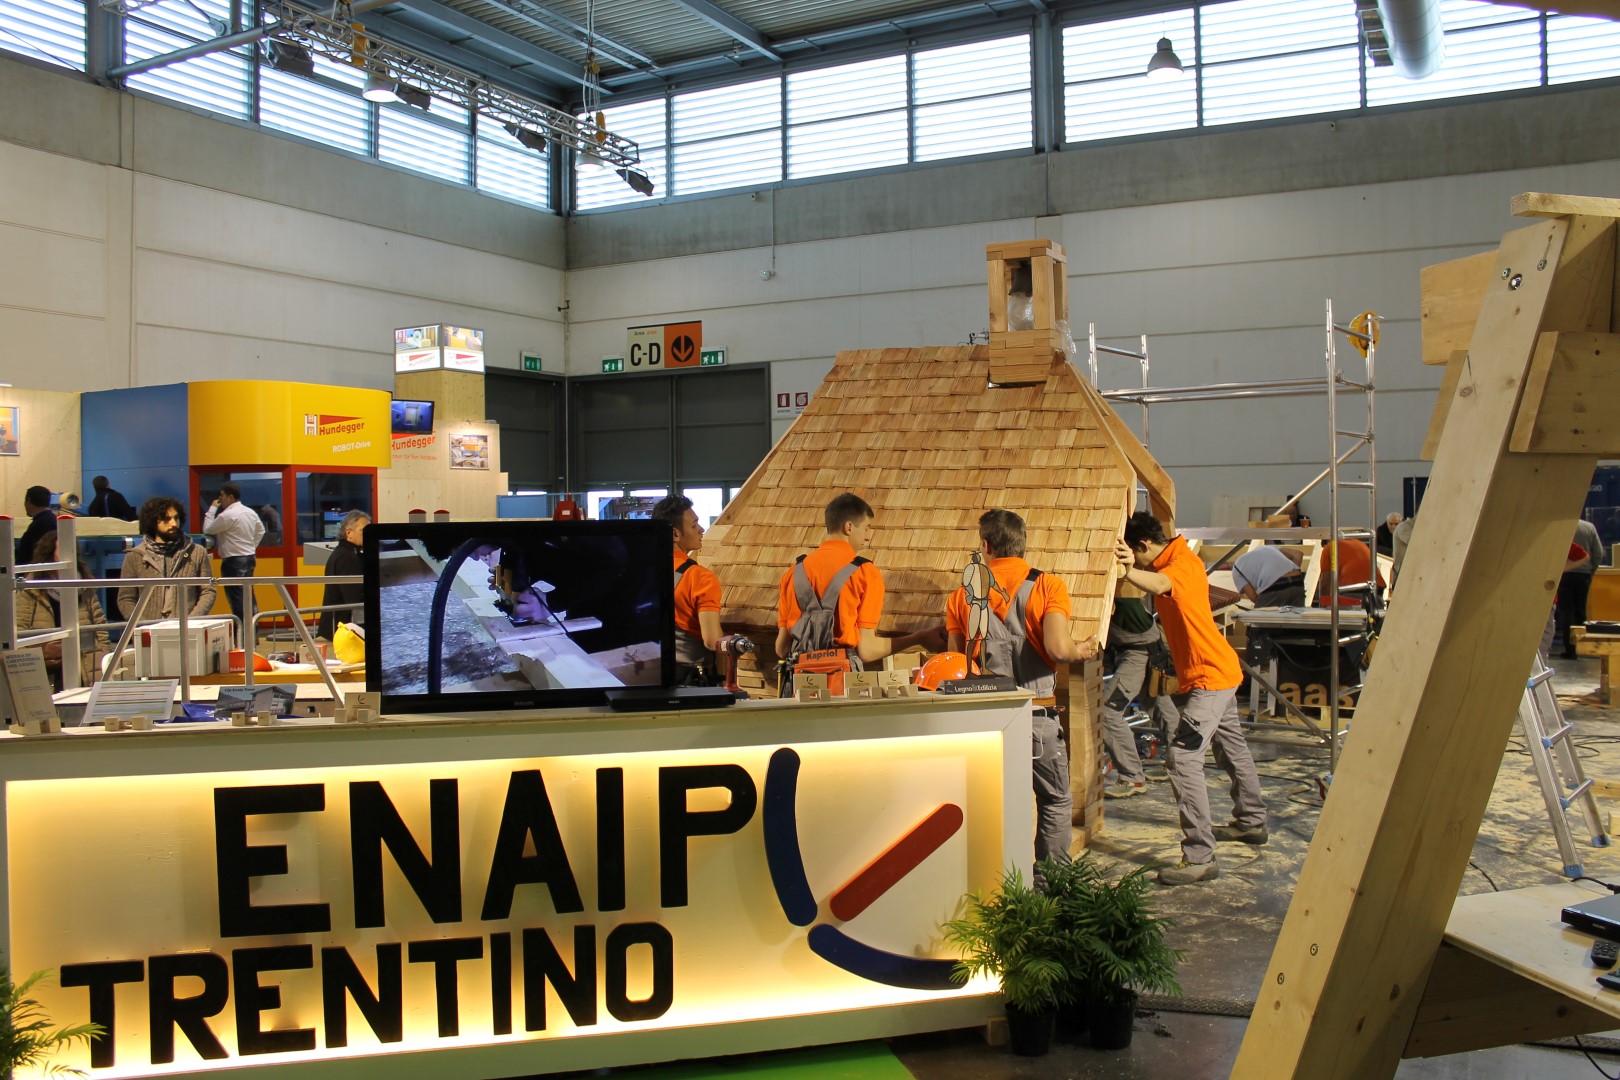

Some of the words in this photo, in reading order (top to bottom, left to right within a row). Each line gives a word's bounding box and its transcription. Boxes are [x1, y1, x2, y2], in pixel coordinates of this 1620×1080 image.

[630, 342, 660, 366] C-D
[319, 421, 365, 436] Hundegger
[332, 441, 371, 453] ROBOT-Drive
[806, 649, 838, 660] Kapriol
[213, 762, 757, 938] ENAIP
[60, 921, 673, 1069] TRENTINO
